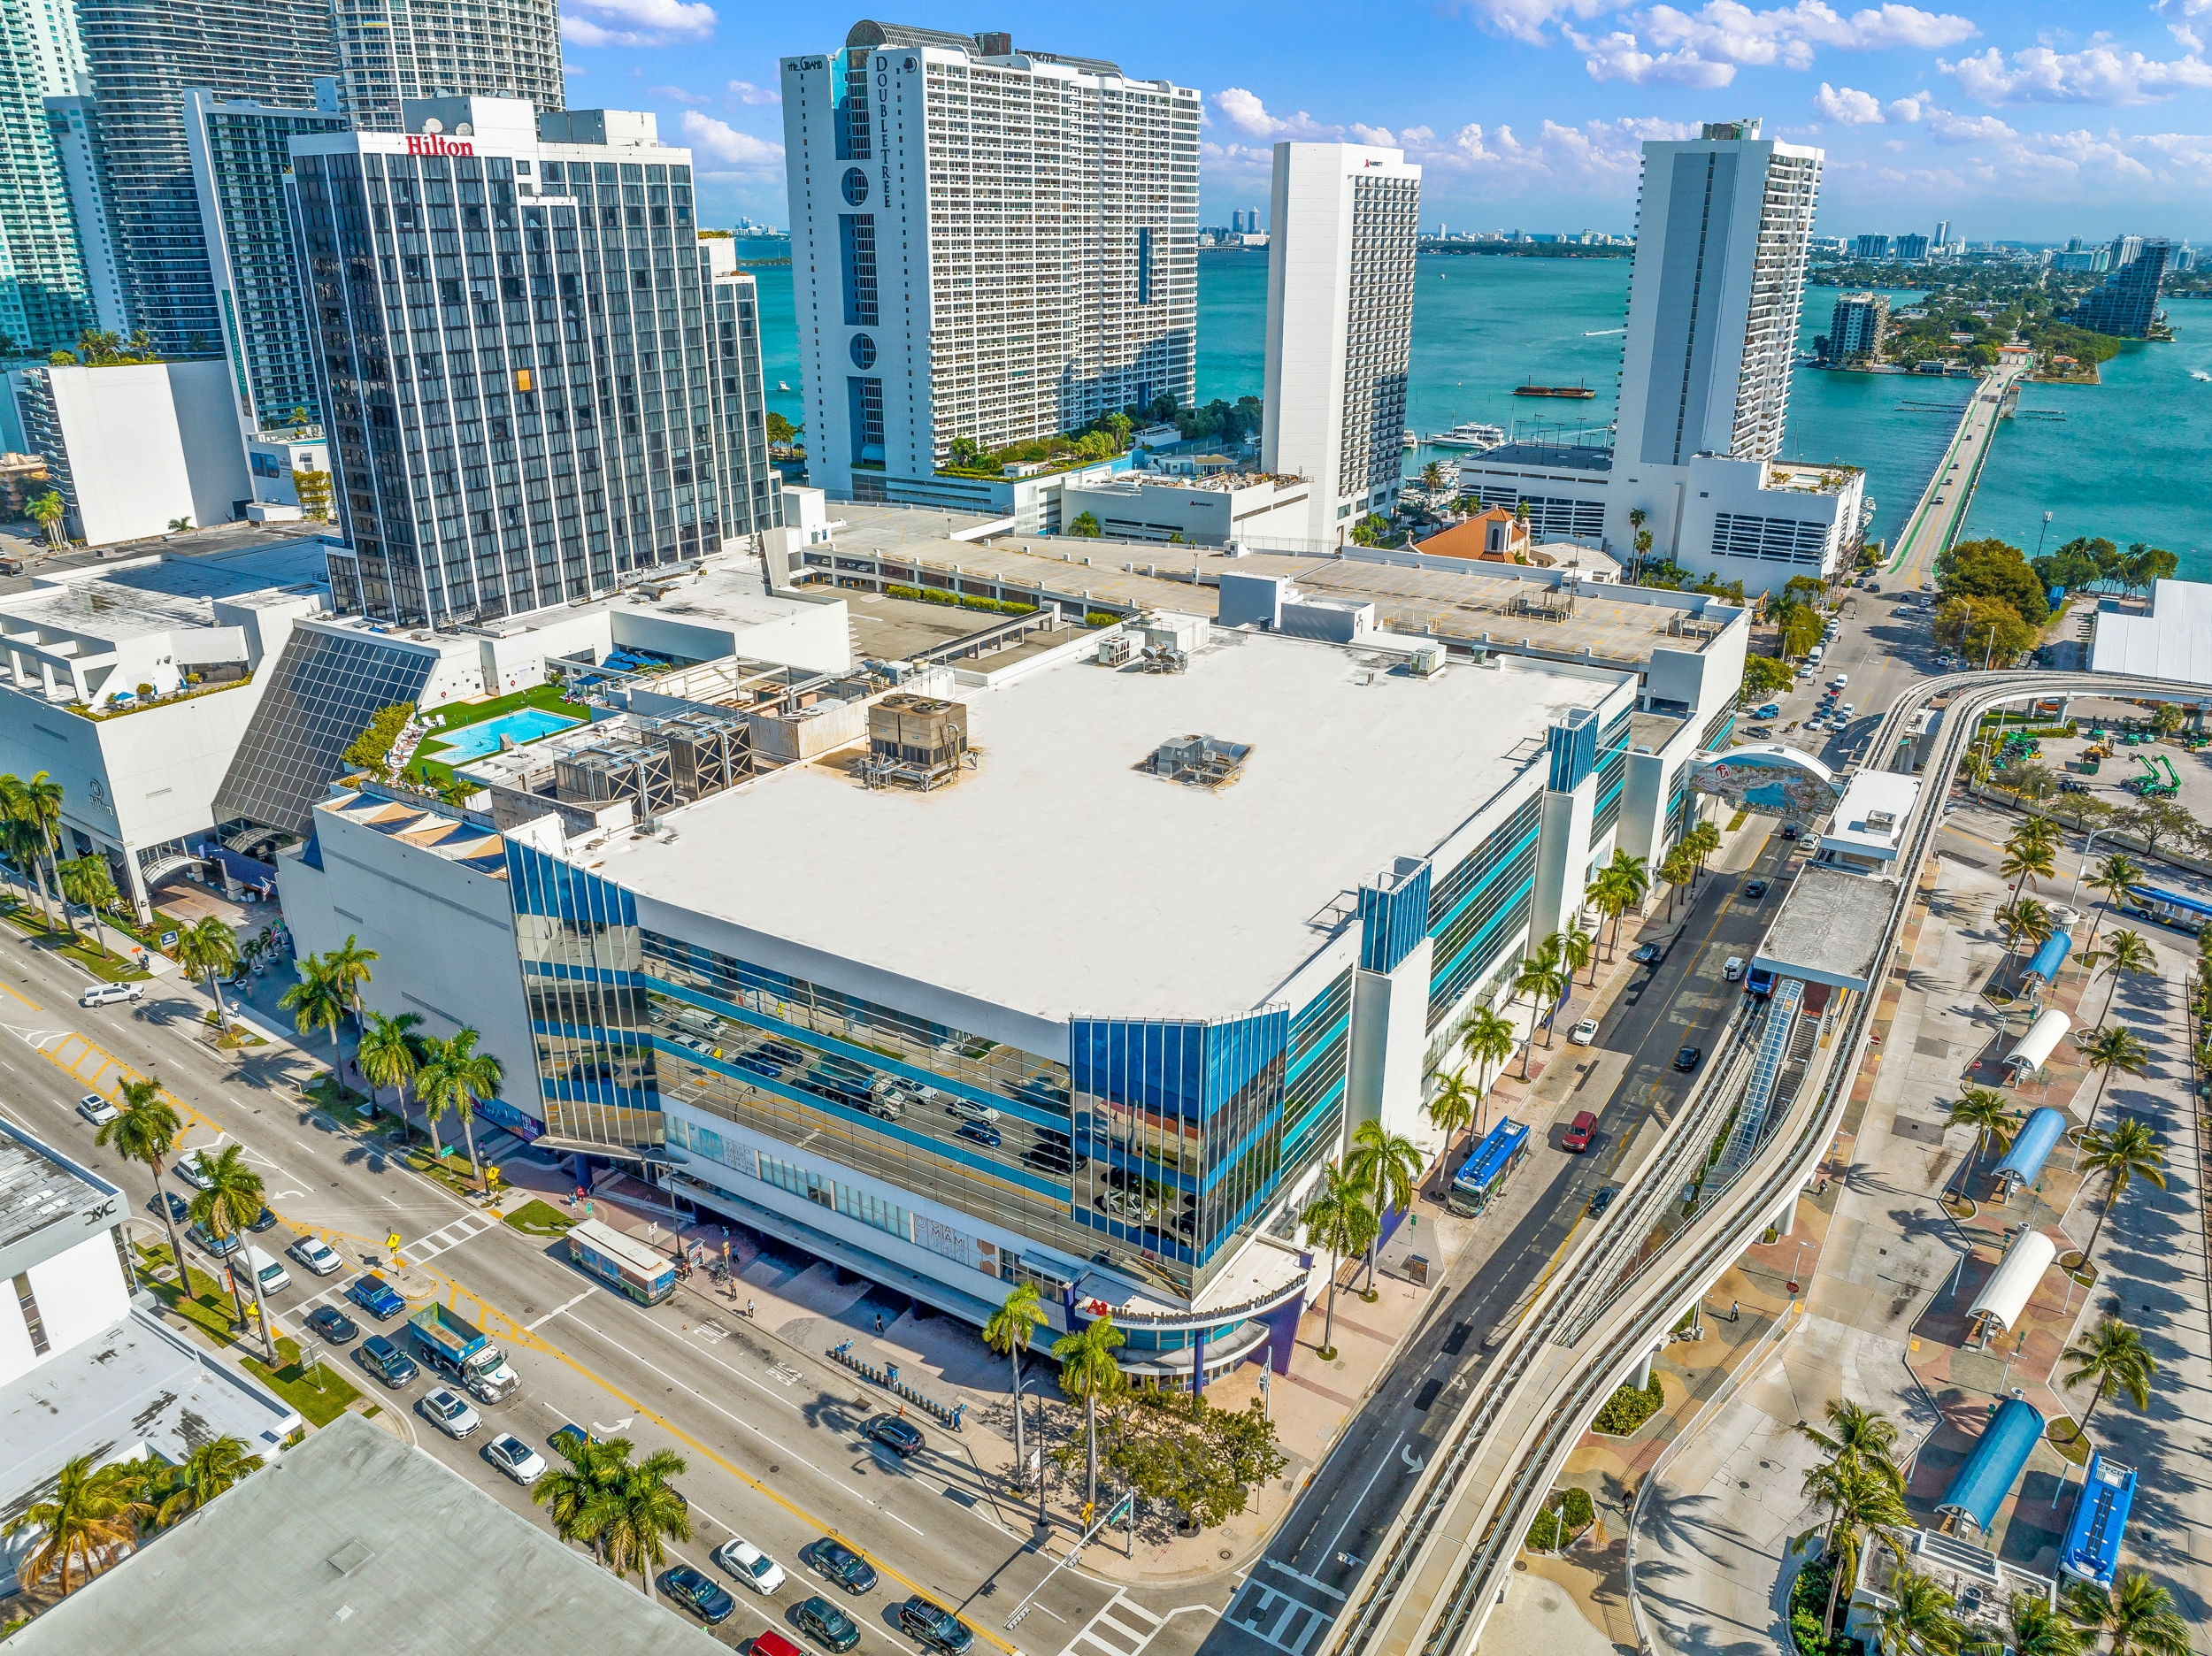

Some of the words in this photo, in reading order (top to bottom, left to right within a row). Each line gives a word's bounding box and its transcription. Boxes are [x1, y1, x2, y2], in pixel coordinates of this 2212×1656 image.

[800, 57, 823, 71] GRAND
[405, 134, 474, 157] Hilton
[875, 56, 891, 208] DOUBLETREE
[235, 354, 247, 387] LUXURY
[932, 1227, 965, 1248] MIAMI
[1111, 1307, 1154, 1323] Miami
[1160, 1299, 1252, 1324] International
[1255, 1271, 1309, 1308] University
